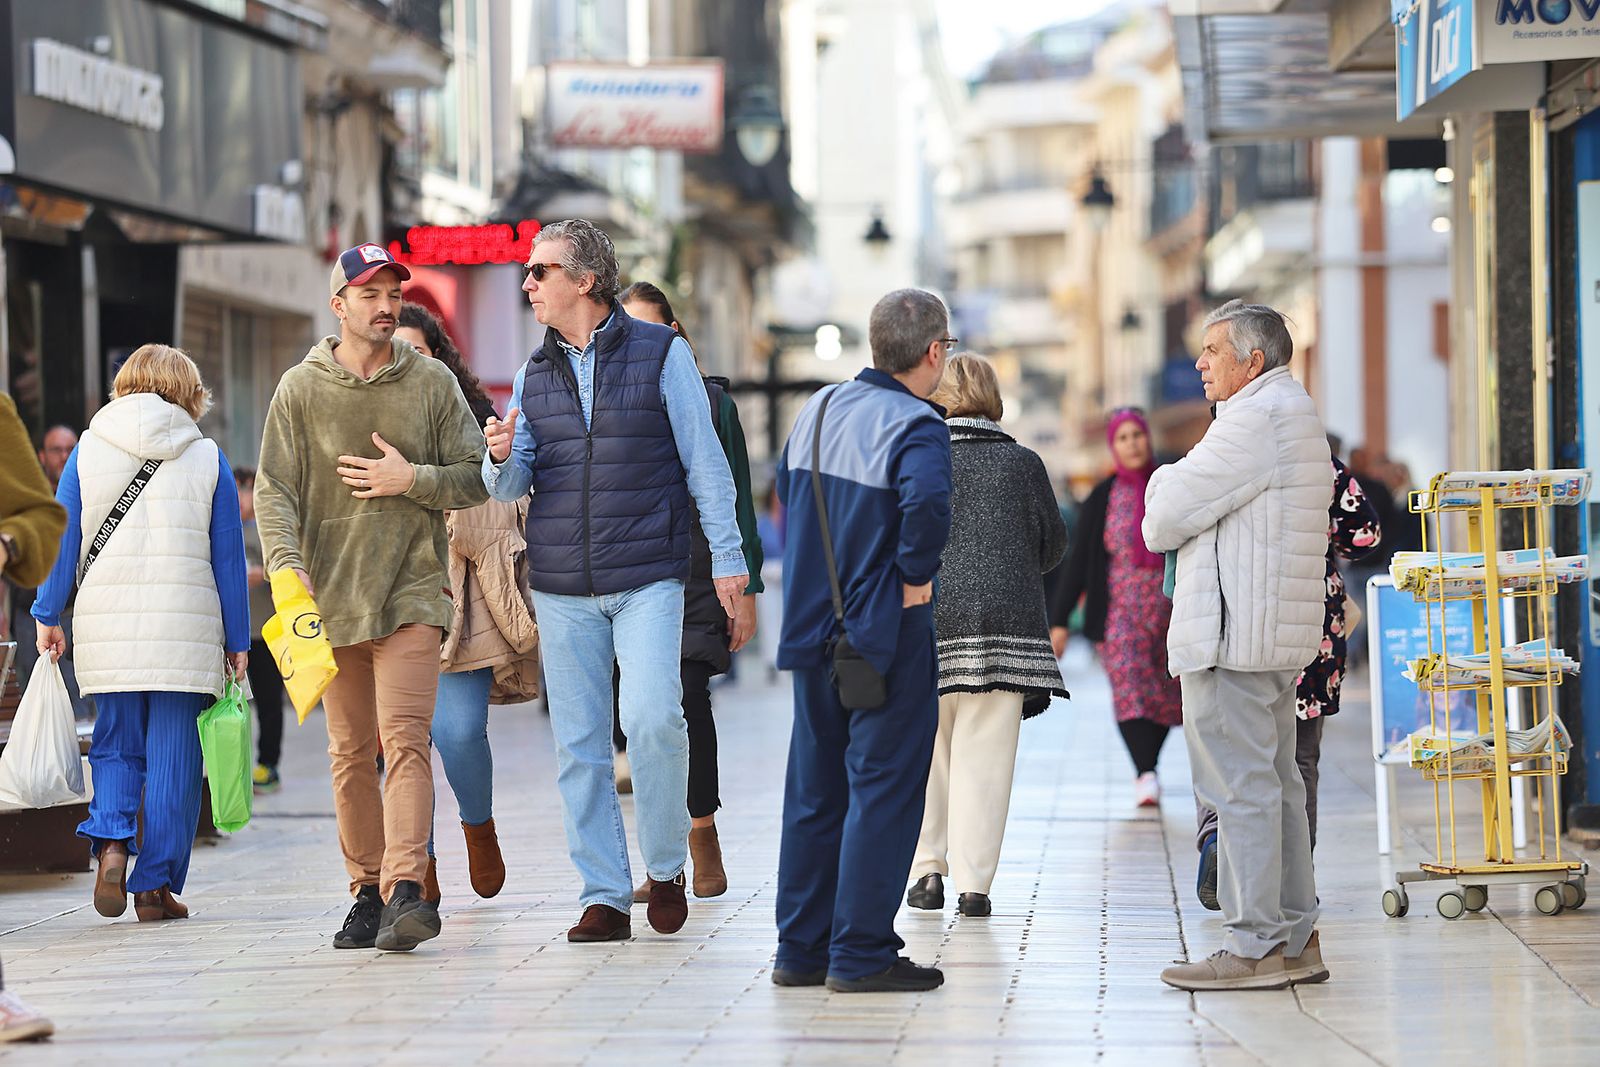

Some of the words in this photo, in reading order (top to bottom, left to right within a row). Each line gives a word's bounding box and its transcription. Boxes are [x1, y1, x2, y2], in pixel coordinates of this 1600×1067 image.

[1513, 29, 1563, 39] Accesorios
[1566, 28, 1578, 37] de
[93, 516, 119, 551] BIMBA
[115, 478, 146, 514] BIMBA
[143, 460, 159, 475] BI
